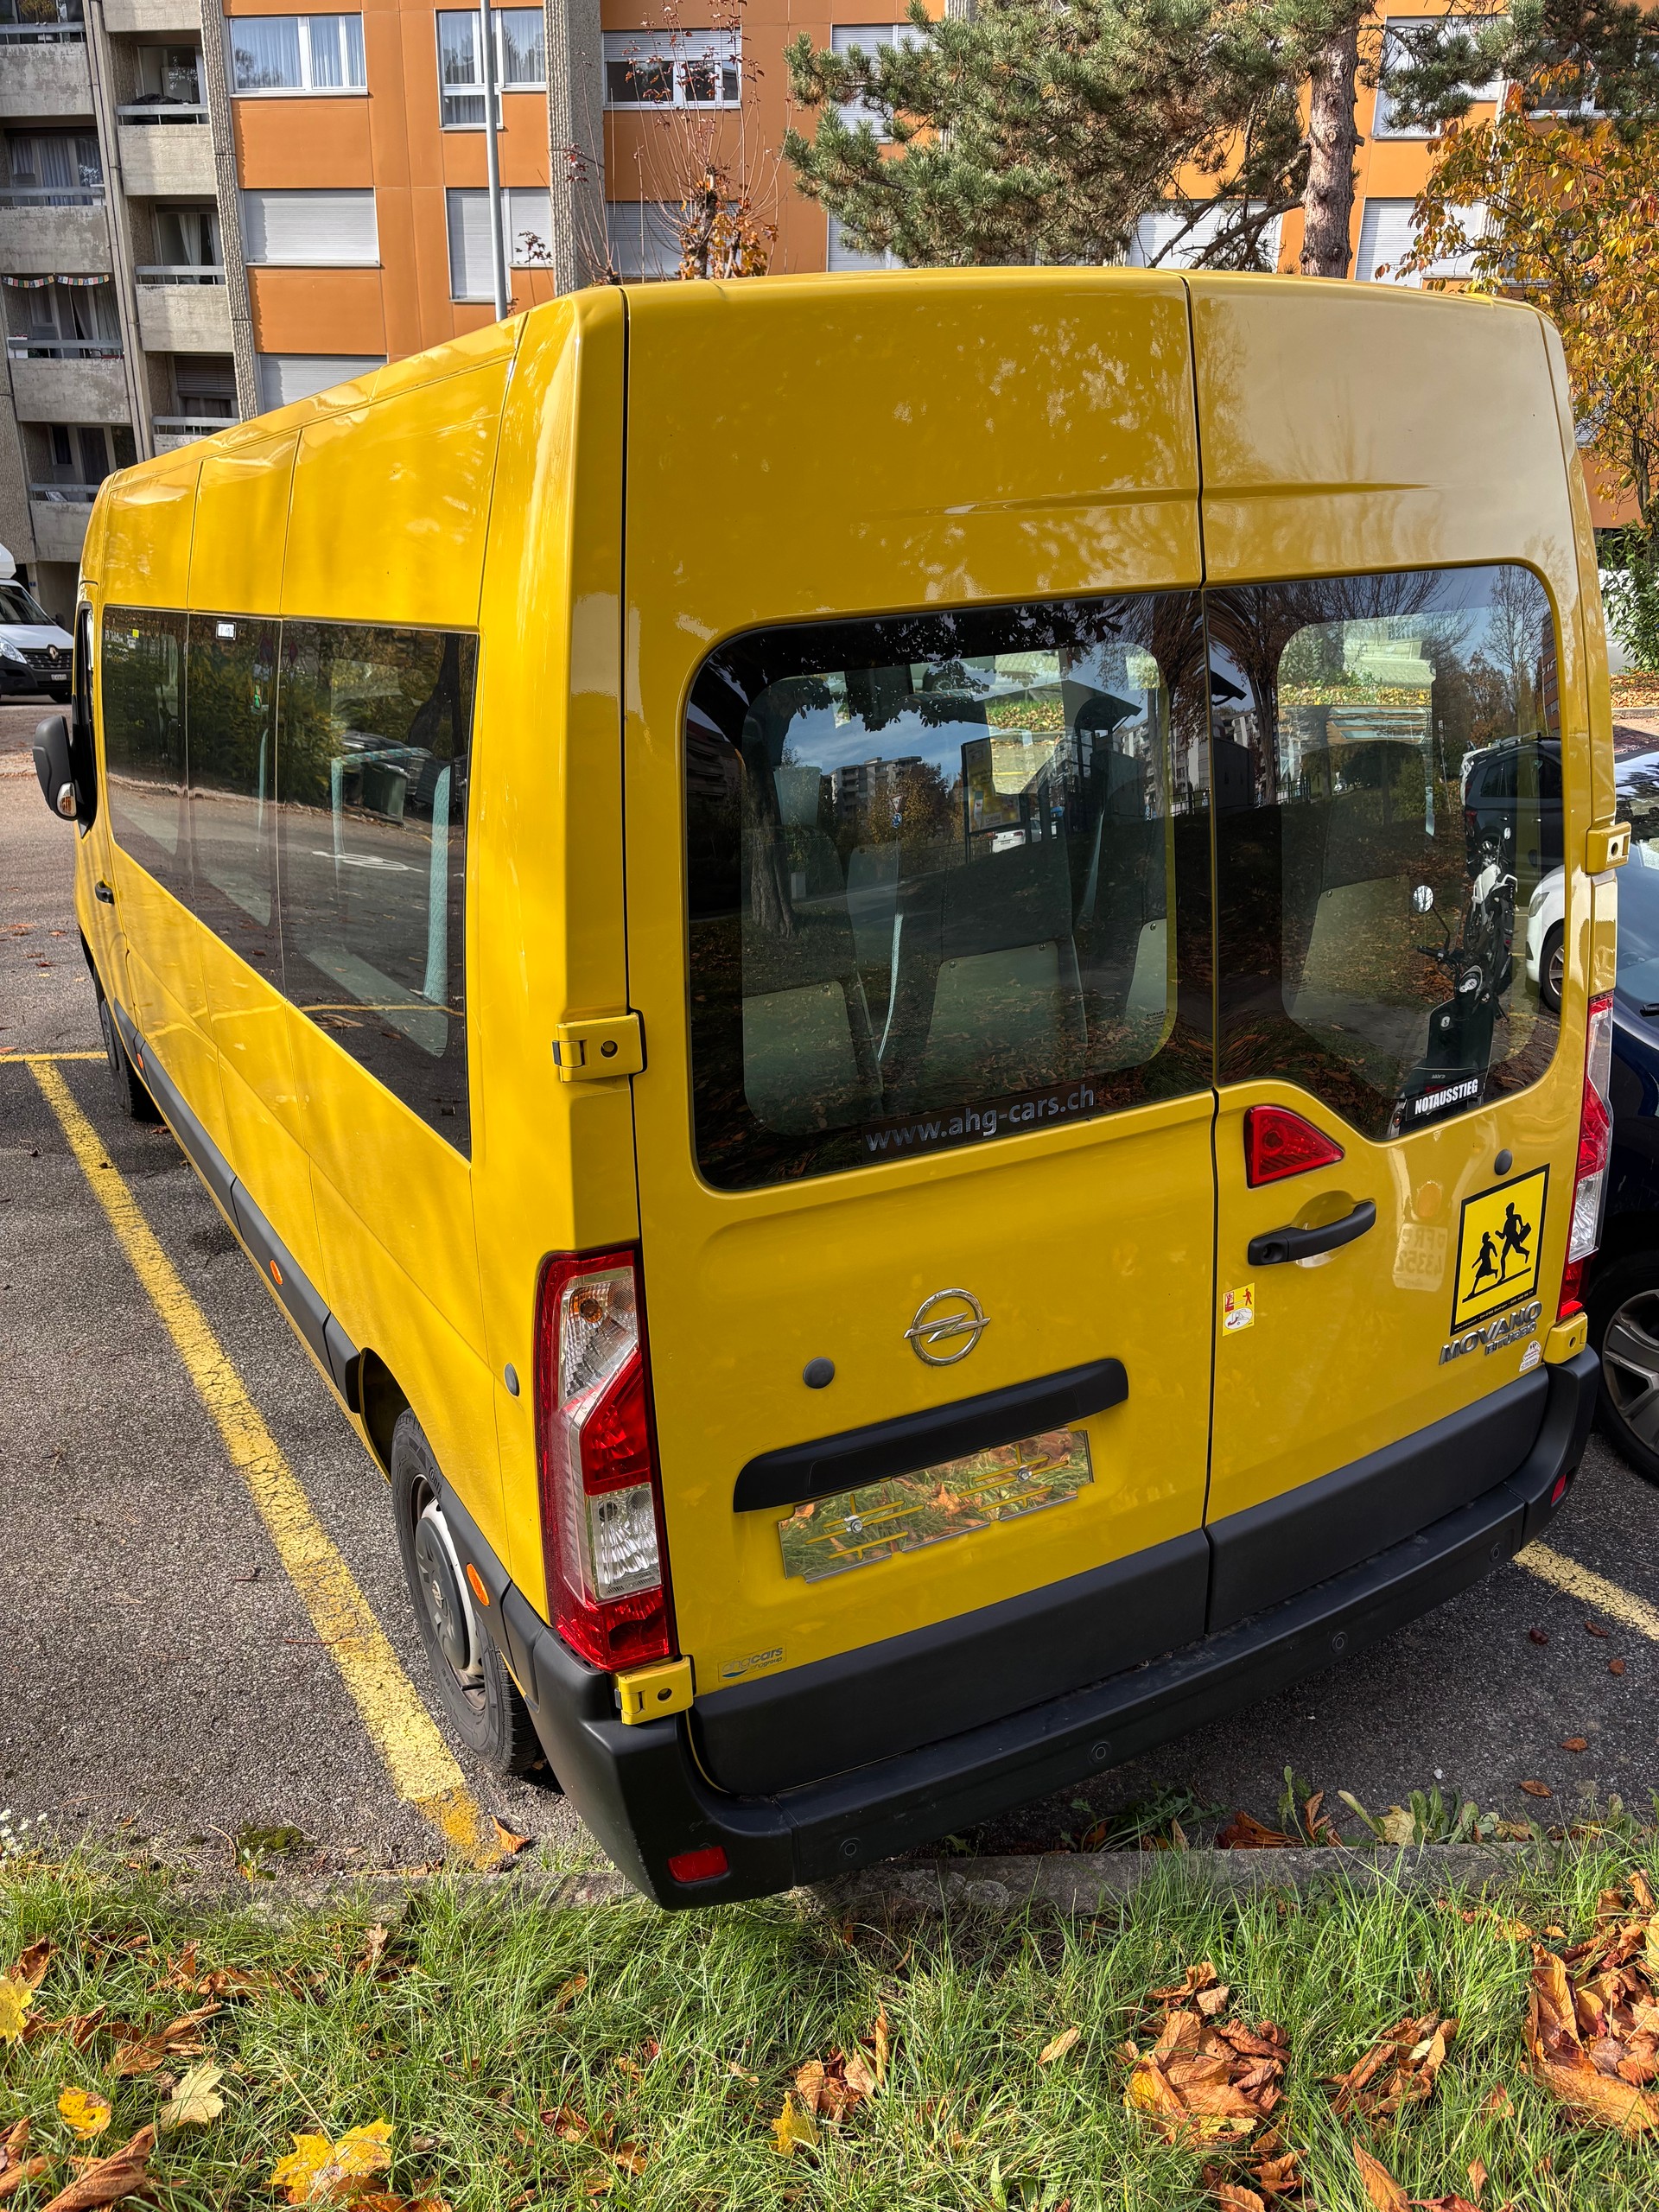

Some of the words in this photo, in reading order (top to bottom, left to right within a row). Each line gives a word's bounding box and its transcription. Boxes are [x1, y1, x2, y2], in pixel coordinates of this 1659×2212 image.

[865, 1084, 1095, 1151] www.ahg-cars.ch
[1414, 1078, 1478, 1116] NOTAUSSTIEG
[1438, 1300, 1542, 1365] MOVANO
[1484, 1321, 1537, 1356] BITURBO
